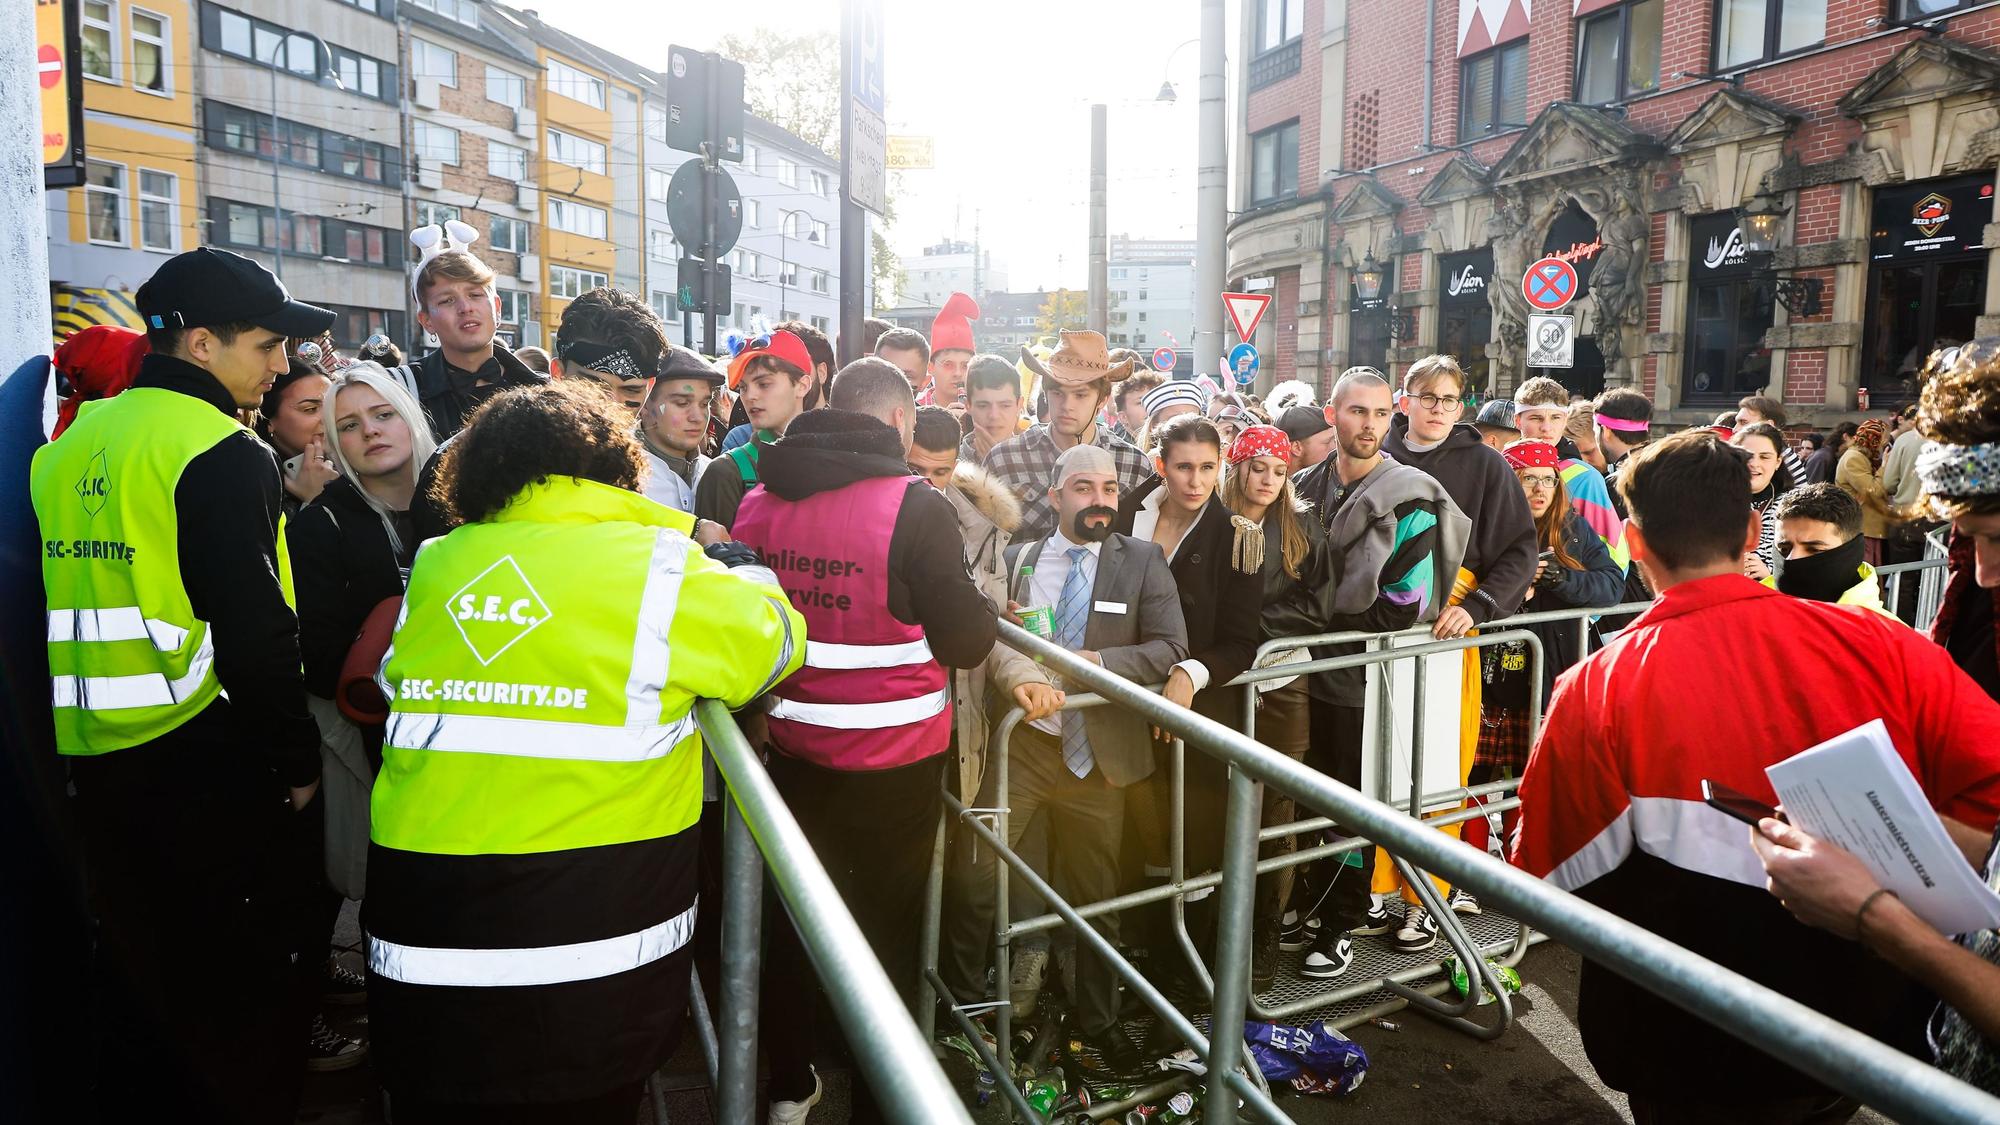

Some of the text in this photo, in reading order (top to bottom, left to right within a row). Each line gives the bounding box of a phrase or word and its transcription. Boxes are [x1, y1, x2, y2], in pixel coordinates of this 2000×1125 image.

[1702, 227, 1748, 269] Sio
[1447, 264, 1485, 297] Sion
[1542, 328, 1560, 344] 30
[458, 594, 539, 627] S.E.C.
[786, 586, 852, 612] rvice
[401, 678, 588, 709] SEC-SECURITY.DE
[1865, 790, 1936, 889] Untermietvertrag
